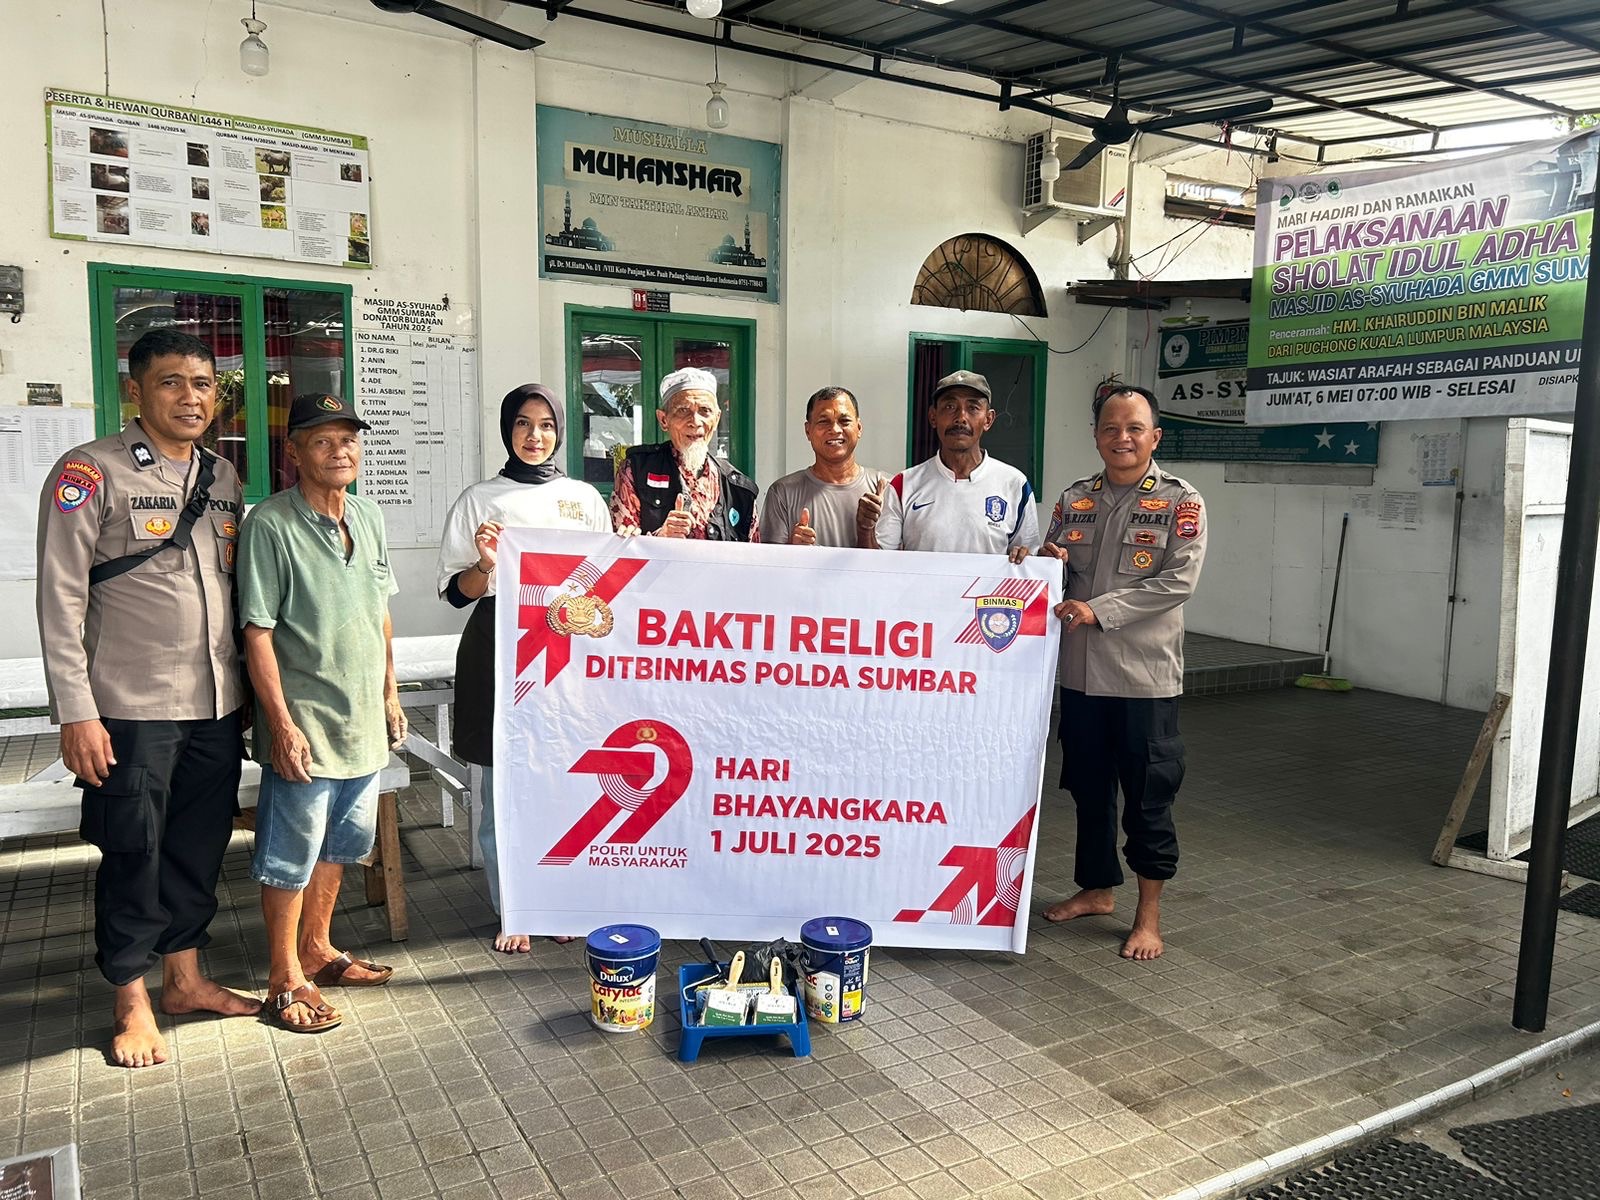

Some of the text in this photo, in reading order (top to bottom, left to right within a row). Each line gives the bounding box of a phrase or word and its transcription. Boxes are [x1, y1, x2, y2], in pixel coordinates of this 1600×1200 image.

[45, 91, 352, 146] PESERTA & HEWAN QURBAN 1446 H MASJID AS-SYUHADA (GMM SUMBAR)
[56, 109, 77, 117] MASJID
[117, 118, 140, 127] QURBAN
[215, 131, 238, 140] QURBAN
[613, 127, 708, 155] MUSHALLA
[572, 147, 743, 198] MUHANSHAR
[589, 192, 619, 207] MIN
[1277, 212, 1307, 229] MARI
[1310, 204, 1359, 222] HADIRI
[1362, 198, 1392, 215] DAN
[1396, 182, 1475, 210] RAMAIKAN
[1275, 197, 1509, 262] PELAKSANAAN
[1273, 252, 1384, 294] SHOLAT
[1388, 241, 1464, 279] IDUL
[1472, 219, 1578, 266] ADHA
[363, 298, 448, 311] MASJID AS-SYUHADA
[1270, 294, 1337, 319] MASJID
[1339, 274, 1464, 311] AS-SYUHADA
[1469, 264, 1529, 291] GMM
[377, 307, 436, 318] GMM SUMBAR
[380, 322, 409, 330] TAHUN
[1269, 295, 1548, 341] Penceramah: HM. KHAIRUDDIN BIN MALIK
[1268, 318, 1549, 358] DARI PUCHONG KUALA LUMPUR MALAYSIA
[1267, 350, 1560, 385] TAJUK: WASIAT ARAFAH SEBAGAI PANDUAN
[1266, 379, 1516, 407] JUM'AT, 6 MEI 07:00 WIB SELESAI
[362, 408, 390, 416] /CAMAT
[130, 496, 177, 510] ZAKARIA
[1131, 513, 1170, 526] POLRI
[983, 598, 1017, 607] BINMAS
[637, 608, 933, 659] BAKTI RELIGI
[585, 655, 977, 695] DITBINMAS POLDA SUMBAR
[714, 757, 790, 782] HARI
[712, 793, 947, 825] BHAYANGKARA
[589, 845, 687, 857] POLRI UNTUK
[710, 830, 881, 859] 1 JULI 2025
[588, 856, 688, 868] MASYARAKAT
[600, 971, 630, 983] Dulux
